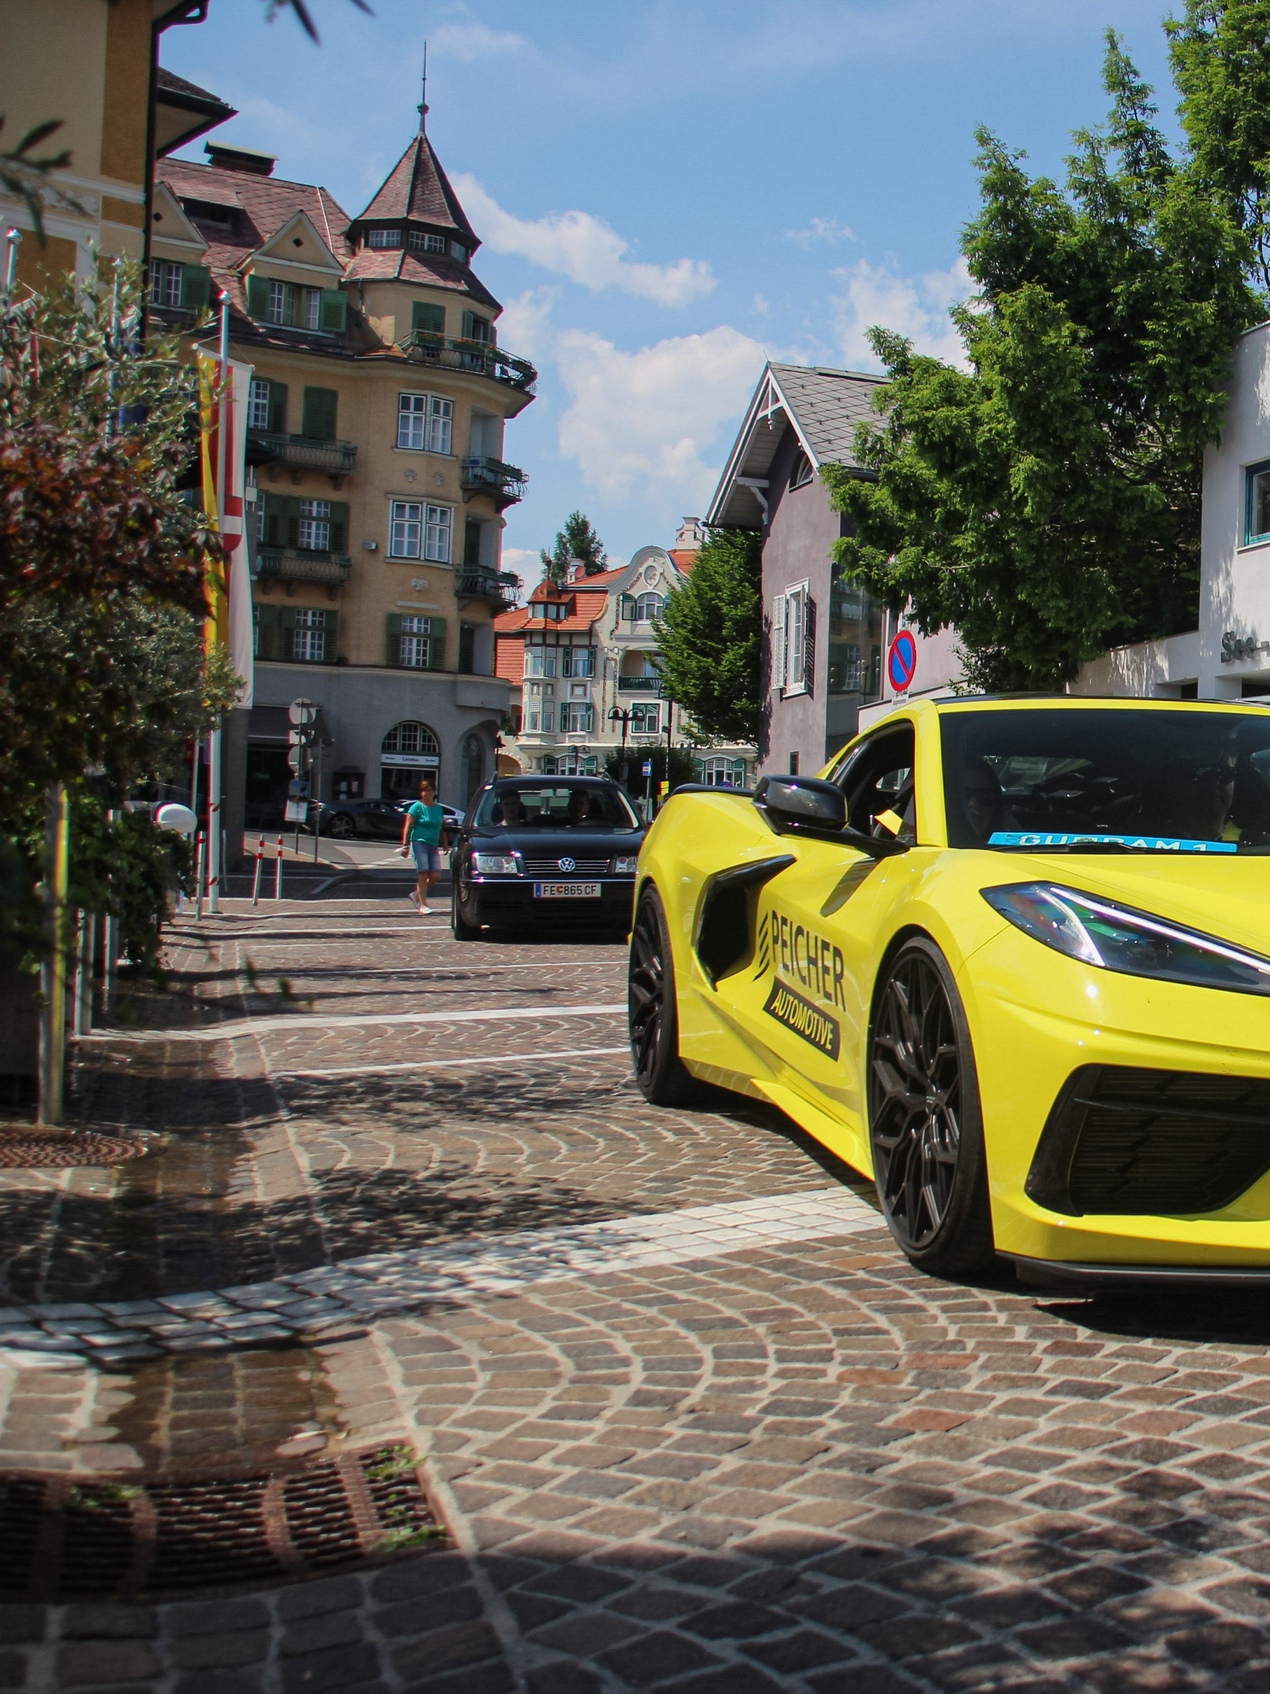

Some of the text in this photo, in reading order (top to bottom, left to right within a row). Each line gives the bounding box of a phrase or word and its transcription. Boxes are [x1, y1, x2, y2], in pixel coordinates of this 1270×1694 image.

[543, 885, 556, 896] FE
[771, 909, 847, 1012] PEICHER
[769, 988, 834, 1051] AUTOMOTIVE
